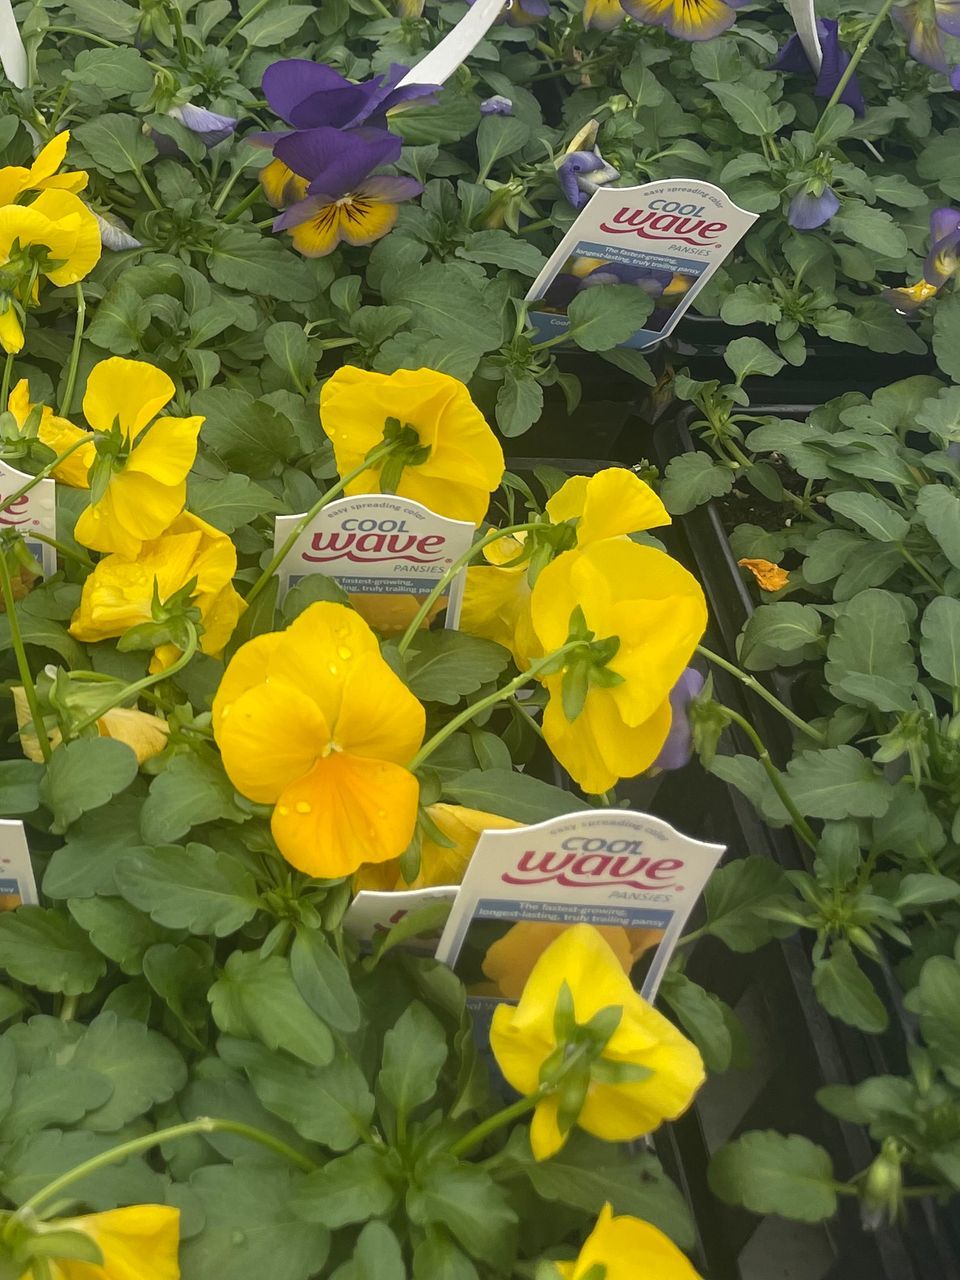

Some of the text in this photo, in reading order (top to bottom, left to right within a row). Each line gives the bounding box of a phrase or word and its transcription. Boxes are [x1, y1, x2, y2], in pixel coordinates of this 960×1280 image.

[648, 199, 705, 218] COOL
[612, 207, 728, 240] wave
[668, 244, 713, 257] PANSIES
[327, 501, 427, 520] easy spreading color
[340, 518, 410, 533] COOL
[311, 532, 446, 554] wave
[393, 564, 446, 574] PANSIES
[385, 585, 417, 594] trailing
[561, 836, 644, 856] COOL
[517, 850, 685, 880] wave
[519, 901, 539, 910] The
[607, 891, 673, 903] PANSIES
